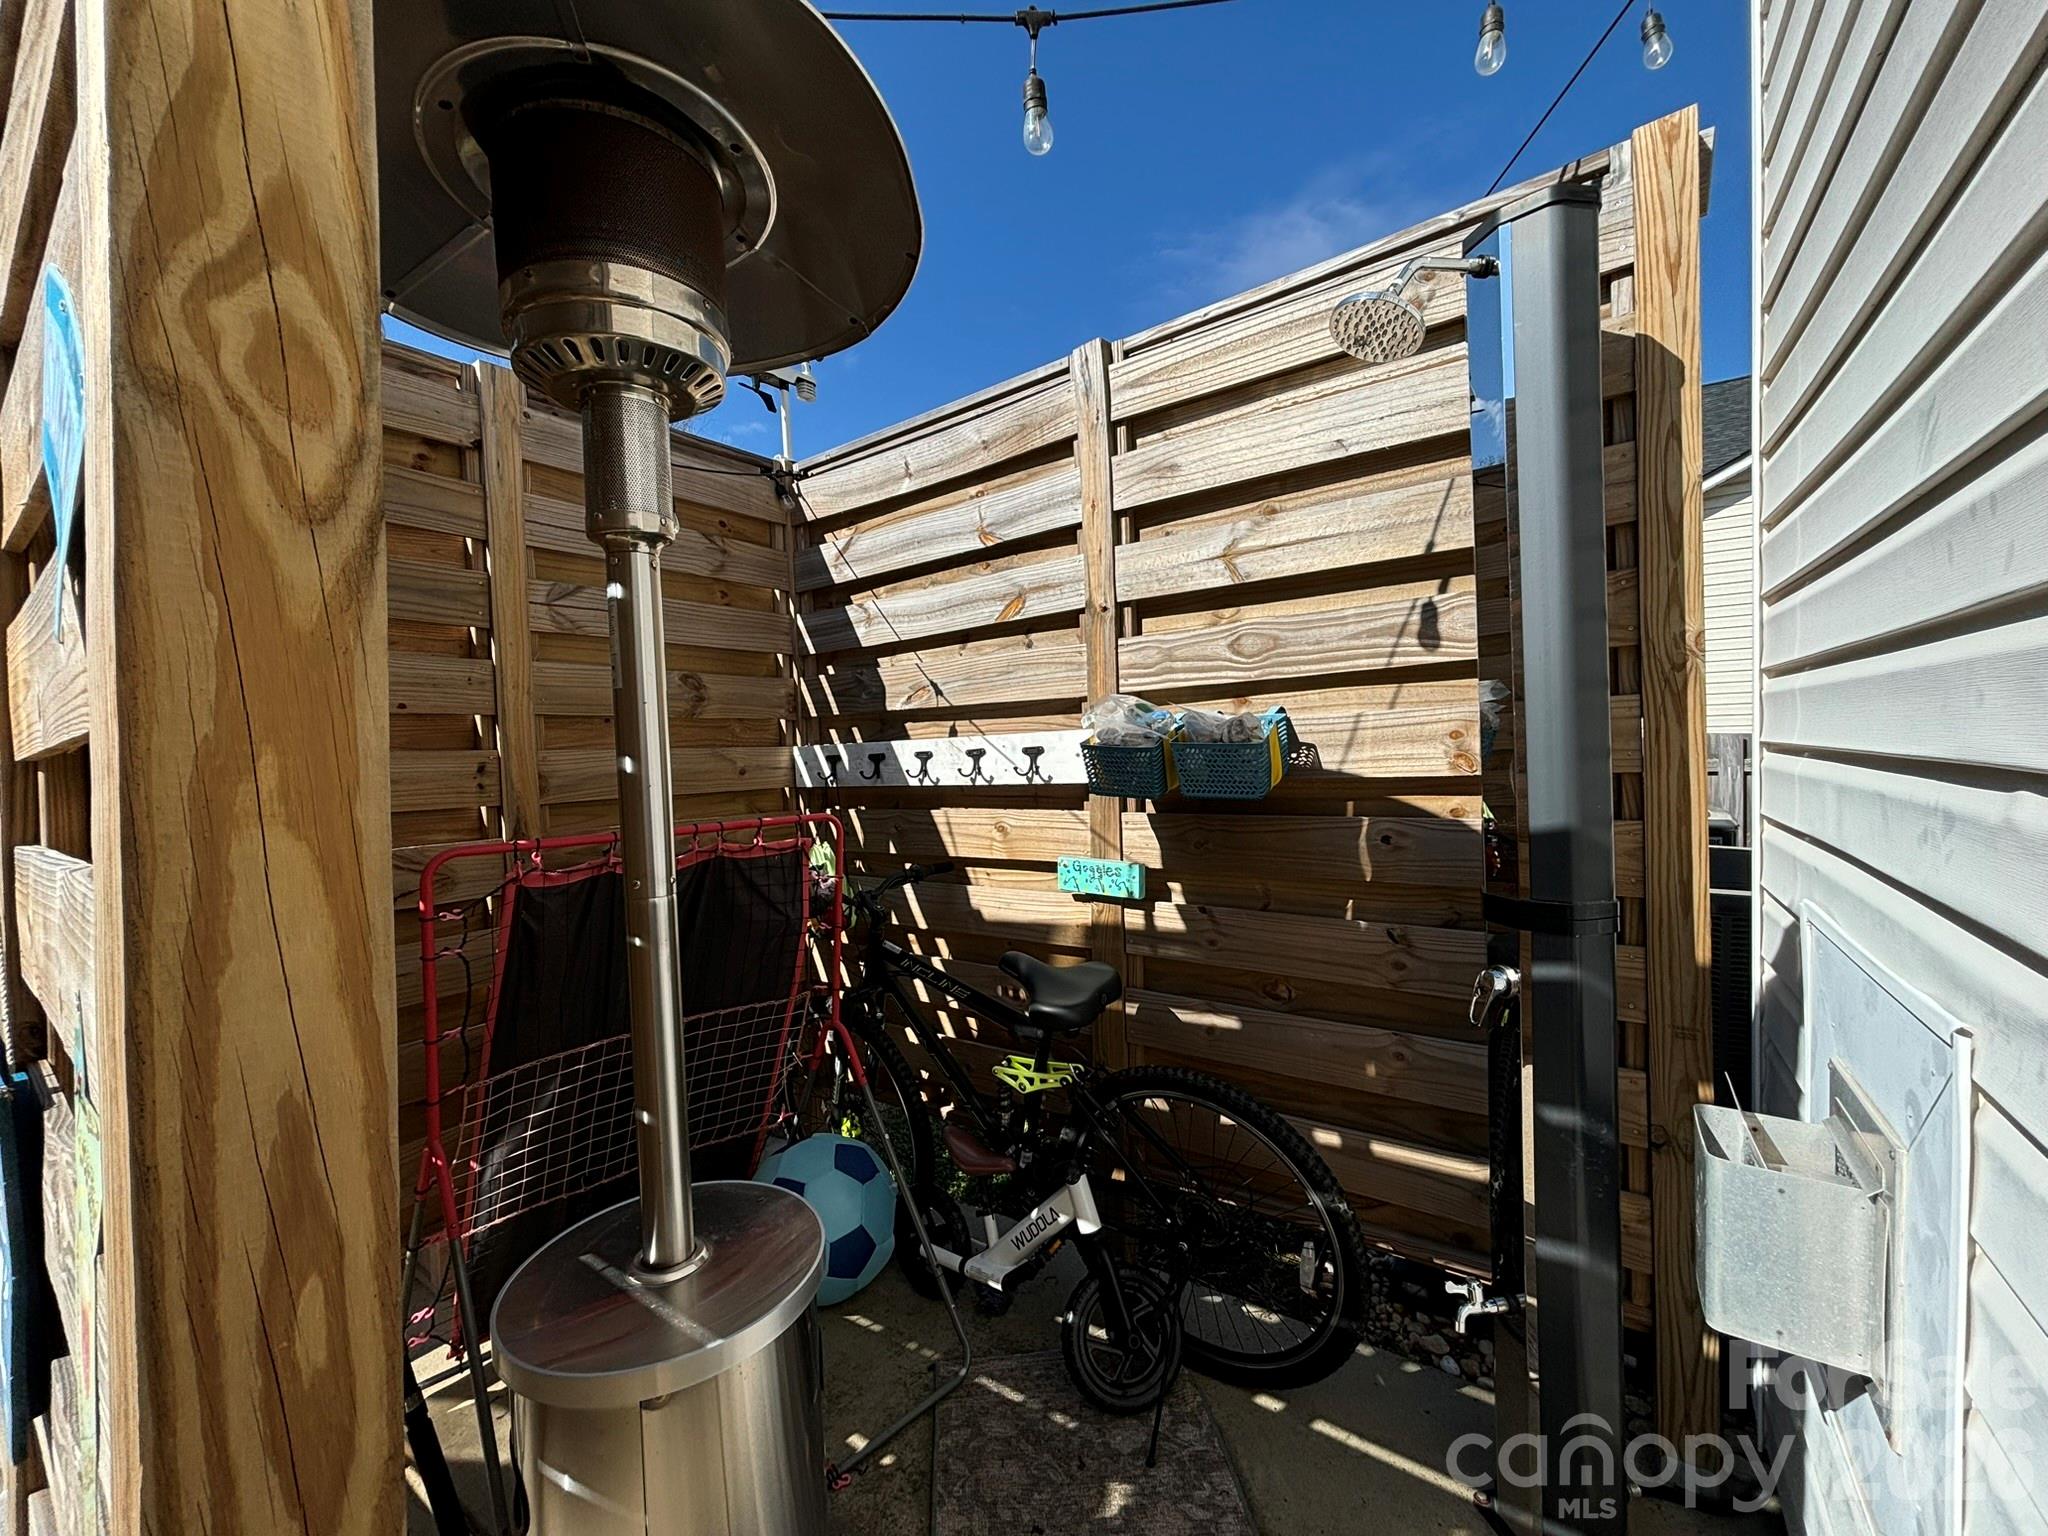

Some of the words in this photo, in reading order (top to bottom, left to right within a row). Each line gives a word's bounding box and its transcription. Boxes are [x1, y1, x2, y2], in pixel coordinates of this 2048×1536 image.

[1073, 860, 1122, 879] Goggles
[900, 958, 971, 999] INCLINE
[1011, 1207, 1060, 1251] WUDOLA
